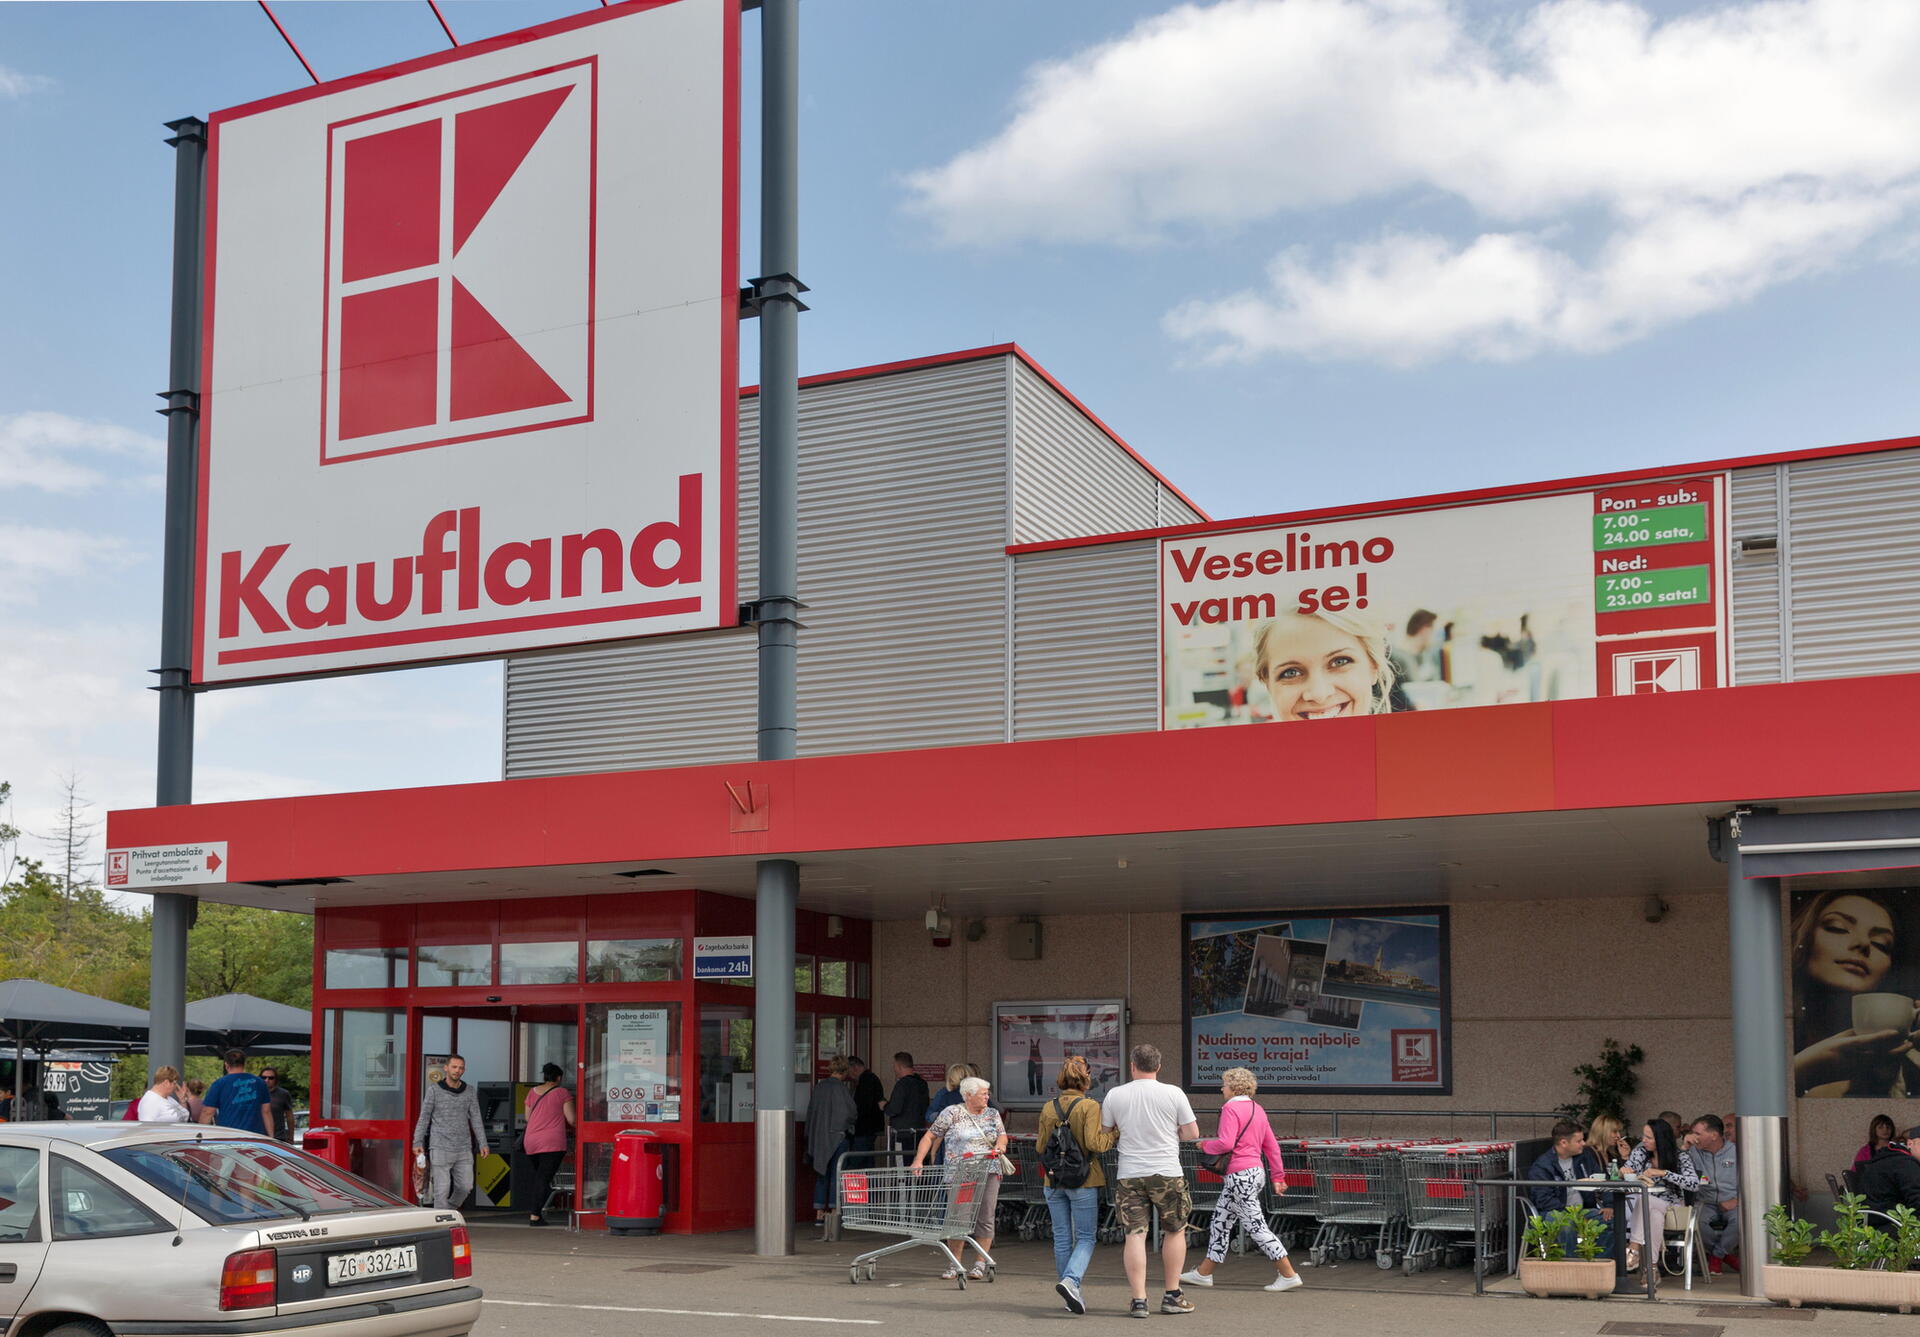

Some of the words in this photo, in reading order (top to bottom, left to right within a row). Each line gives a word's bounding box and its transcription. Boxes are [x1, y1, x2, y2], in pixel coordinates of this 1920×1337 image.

[1600, 497, 1637, 512] Pon
[1657, 489, 1698, 506] sub:
[1603, 530, 1650, 545] 24.00
[1655, 527, 1695, 540] sata,
[218, 472, 702, 639] Kaufland
[1170, 532, 1394, 583] Veselimo
[1602, 555, 1648, 573] Ned:
[1170, 592, 1276, 626] vam
[1297, 572, 1368, 615] se!
[1606, 592, 1653, 607] 23.00
[1657, 587, 1698, 602] sata!
[131, 850, 160, 859] Prihvat
[162, 847, 204, 857] ambalaže
[728, 960, 749, 973] 24h
[615, 1012, 638, 1020] Dobro
[1198, 1033, 1257, 1046] Nudimo
[1262, 1035, 1297, 1046] vam
[1300, 1032, 1361, 1048] najbolje
[1197, 1050, 1210, 1060] iz
[1215, 1048, 1258, 1063] vašeg
[1263, 1048, 1310, 1063] kraja!
[1198, 1064, 1213, 1072] Kod
[266, 1229, 308, 1241] VECTRA
[292, 1269, 311, 1280] HR
[339, 1257, 357, 1278] ZG
